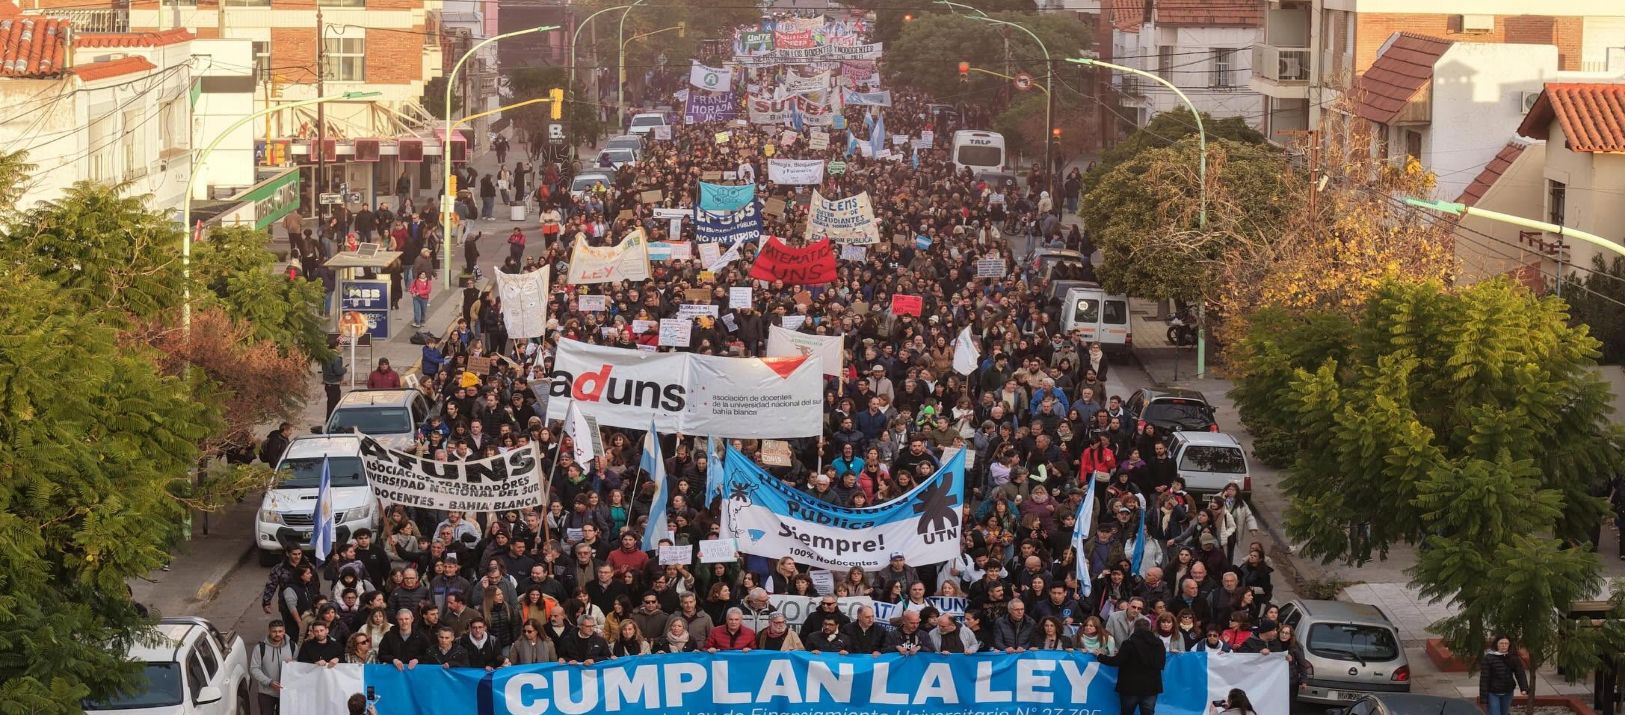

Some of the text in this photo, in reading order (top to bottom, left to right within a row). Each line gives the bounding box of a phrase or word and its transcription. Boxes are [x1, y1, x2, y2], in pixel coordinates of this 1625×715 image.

[691, 102, 733, 114] MORADA
[695, 234, 709, 242] NO
[711, 235, 728, 243] HAY
[581, 266, 614, 280] LEY
[771, 264, 824, 280] UNS
[549, 363, 687, 412] aduns
[712, 394, 748, 402] asociación
[733, 408, 757, 416] blanca
[359, 435, 536, 483] ATUNS
[374, 486, 435, 507] DOCENTES
[493, 496, 538, 510] BLANCA
[429, 483, 495, 498] NACIONAL
[499, 486, 518, 497] DEL
[521, 483, 540, 495] SUR
[778, 521, 885, 555] Siempre!
[923, 527, 958, 545] UTN
[789, 547, 814, 560] 100%
[503, 658, 1100, 715] CUMPLAN LA LEY
